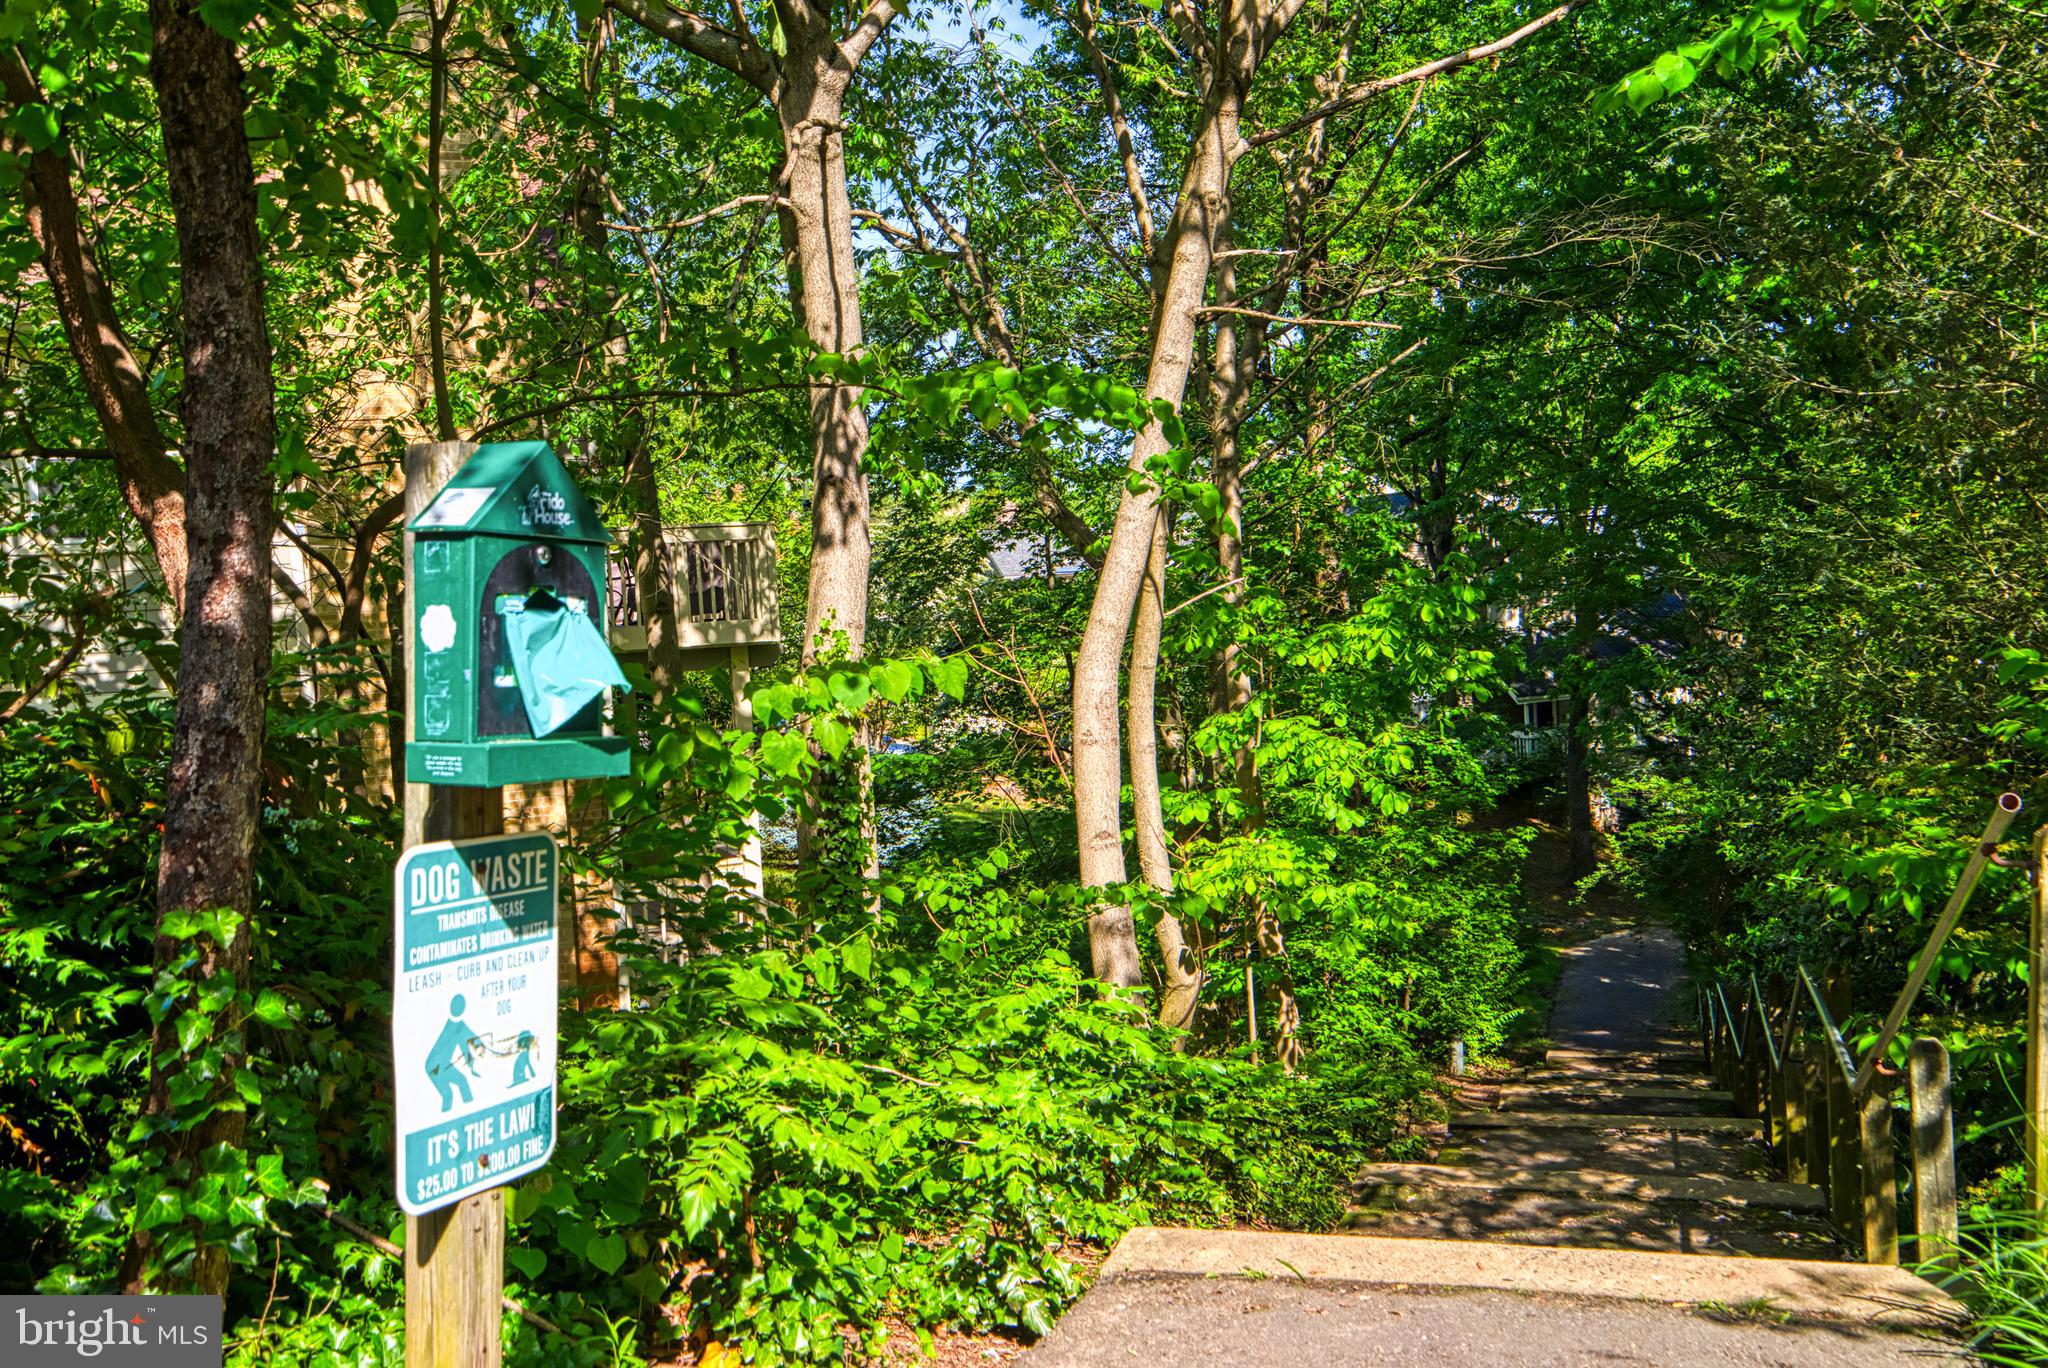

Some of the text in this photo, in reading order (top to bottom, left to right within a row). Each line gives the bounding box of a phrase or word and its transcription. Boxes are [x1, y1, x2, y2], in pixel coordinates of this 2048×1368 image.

[534, 509, 571, 526] House
[411, 849, 548, 906] DOG WASTE
[437, 899, 526, 932] TRANSMITS DISEASE
[409, 921, 549, 967] CONTAMINATES DRINKING WATER
[409, 971, 442, 993] LEASH
[457, 965, 481, 981] CURB
[486, 958, 503, 973] AND
[507, 950, 535, 969] CLEAN
[539, 946, 550, 962] UP
[481, 974, 527, 999] AFTER YOUR
[497, 999, 512, 1016] DOG
[427, 1102, 536, 1167] IT'S THE LAW!
[417, 1167, 458, 1202] $25.00
[461, 1161, 474, 1183] TO
[523, 1134, 544, 1161] FINE
